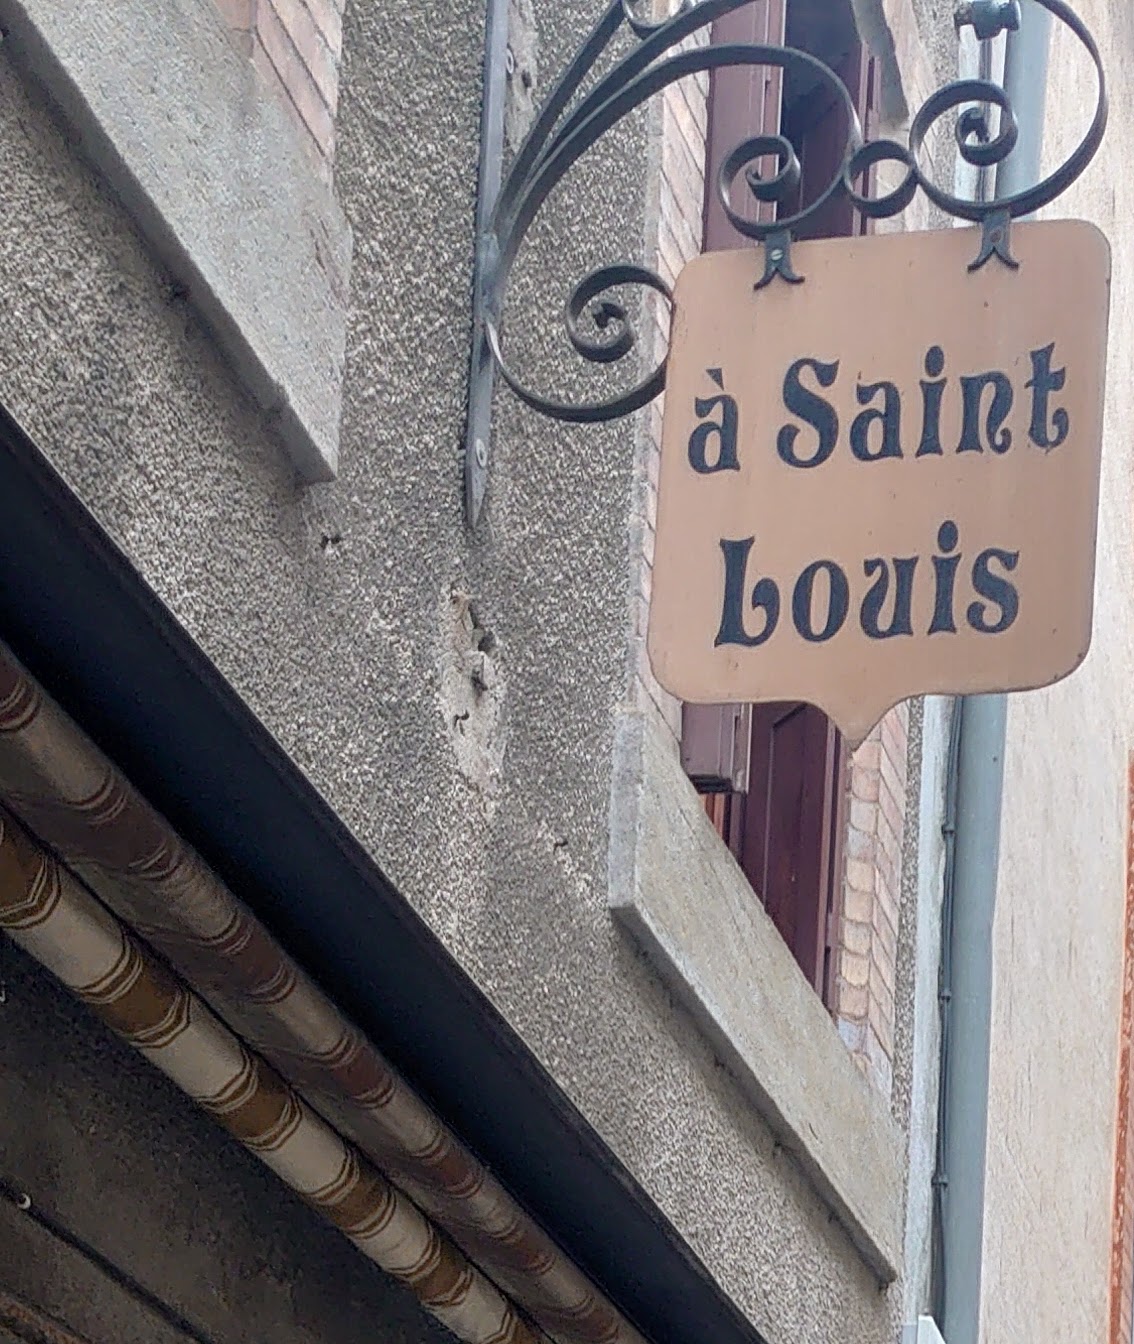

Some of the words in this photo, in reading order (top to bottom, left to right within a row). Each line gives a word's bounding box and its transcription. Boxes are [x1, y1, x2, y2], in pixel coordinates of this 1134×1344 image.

[687, 367, 742, 474] à
[776, 341, 1070, 470] Saint
[714, 519, 1021, 649] Louis
